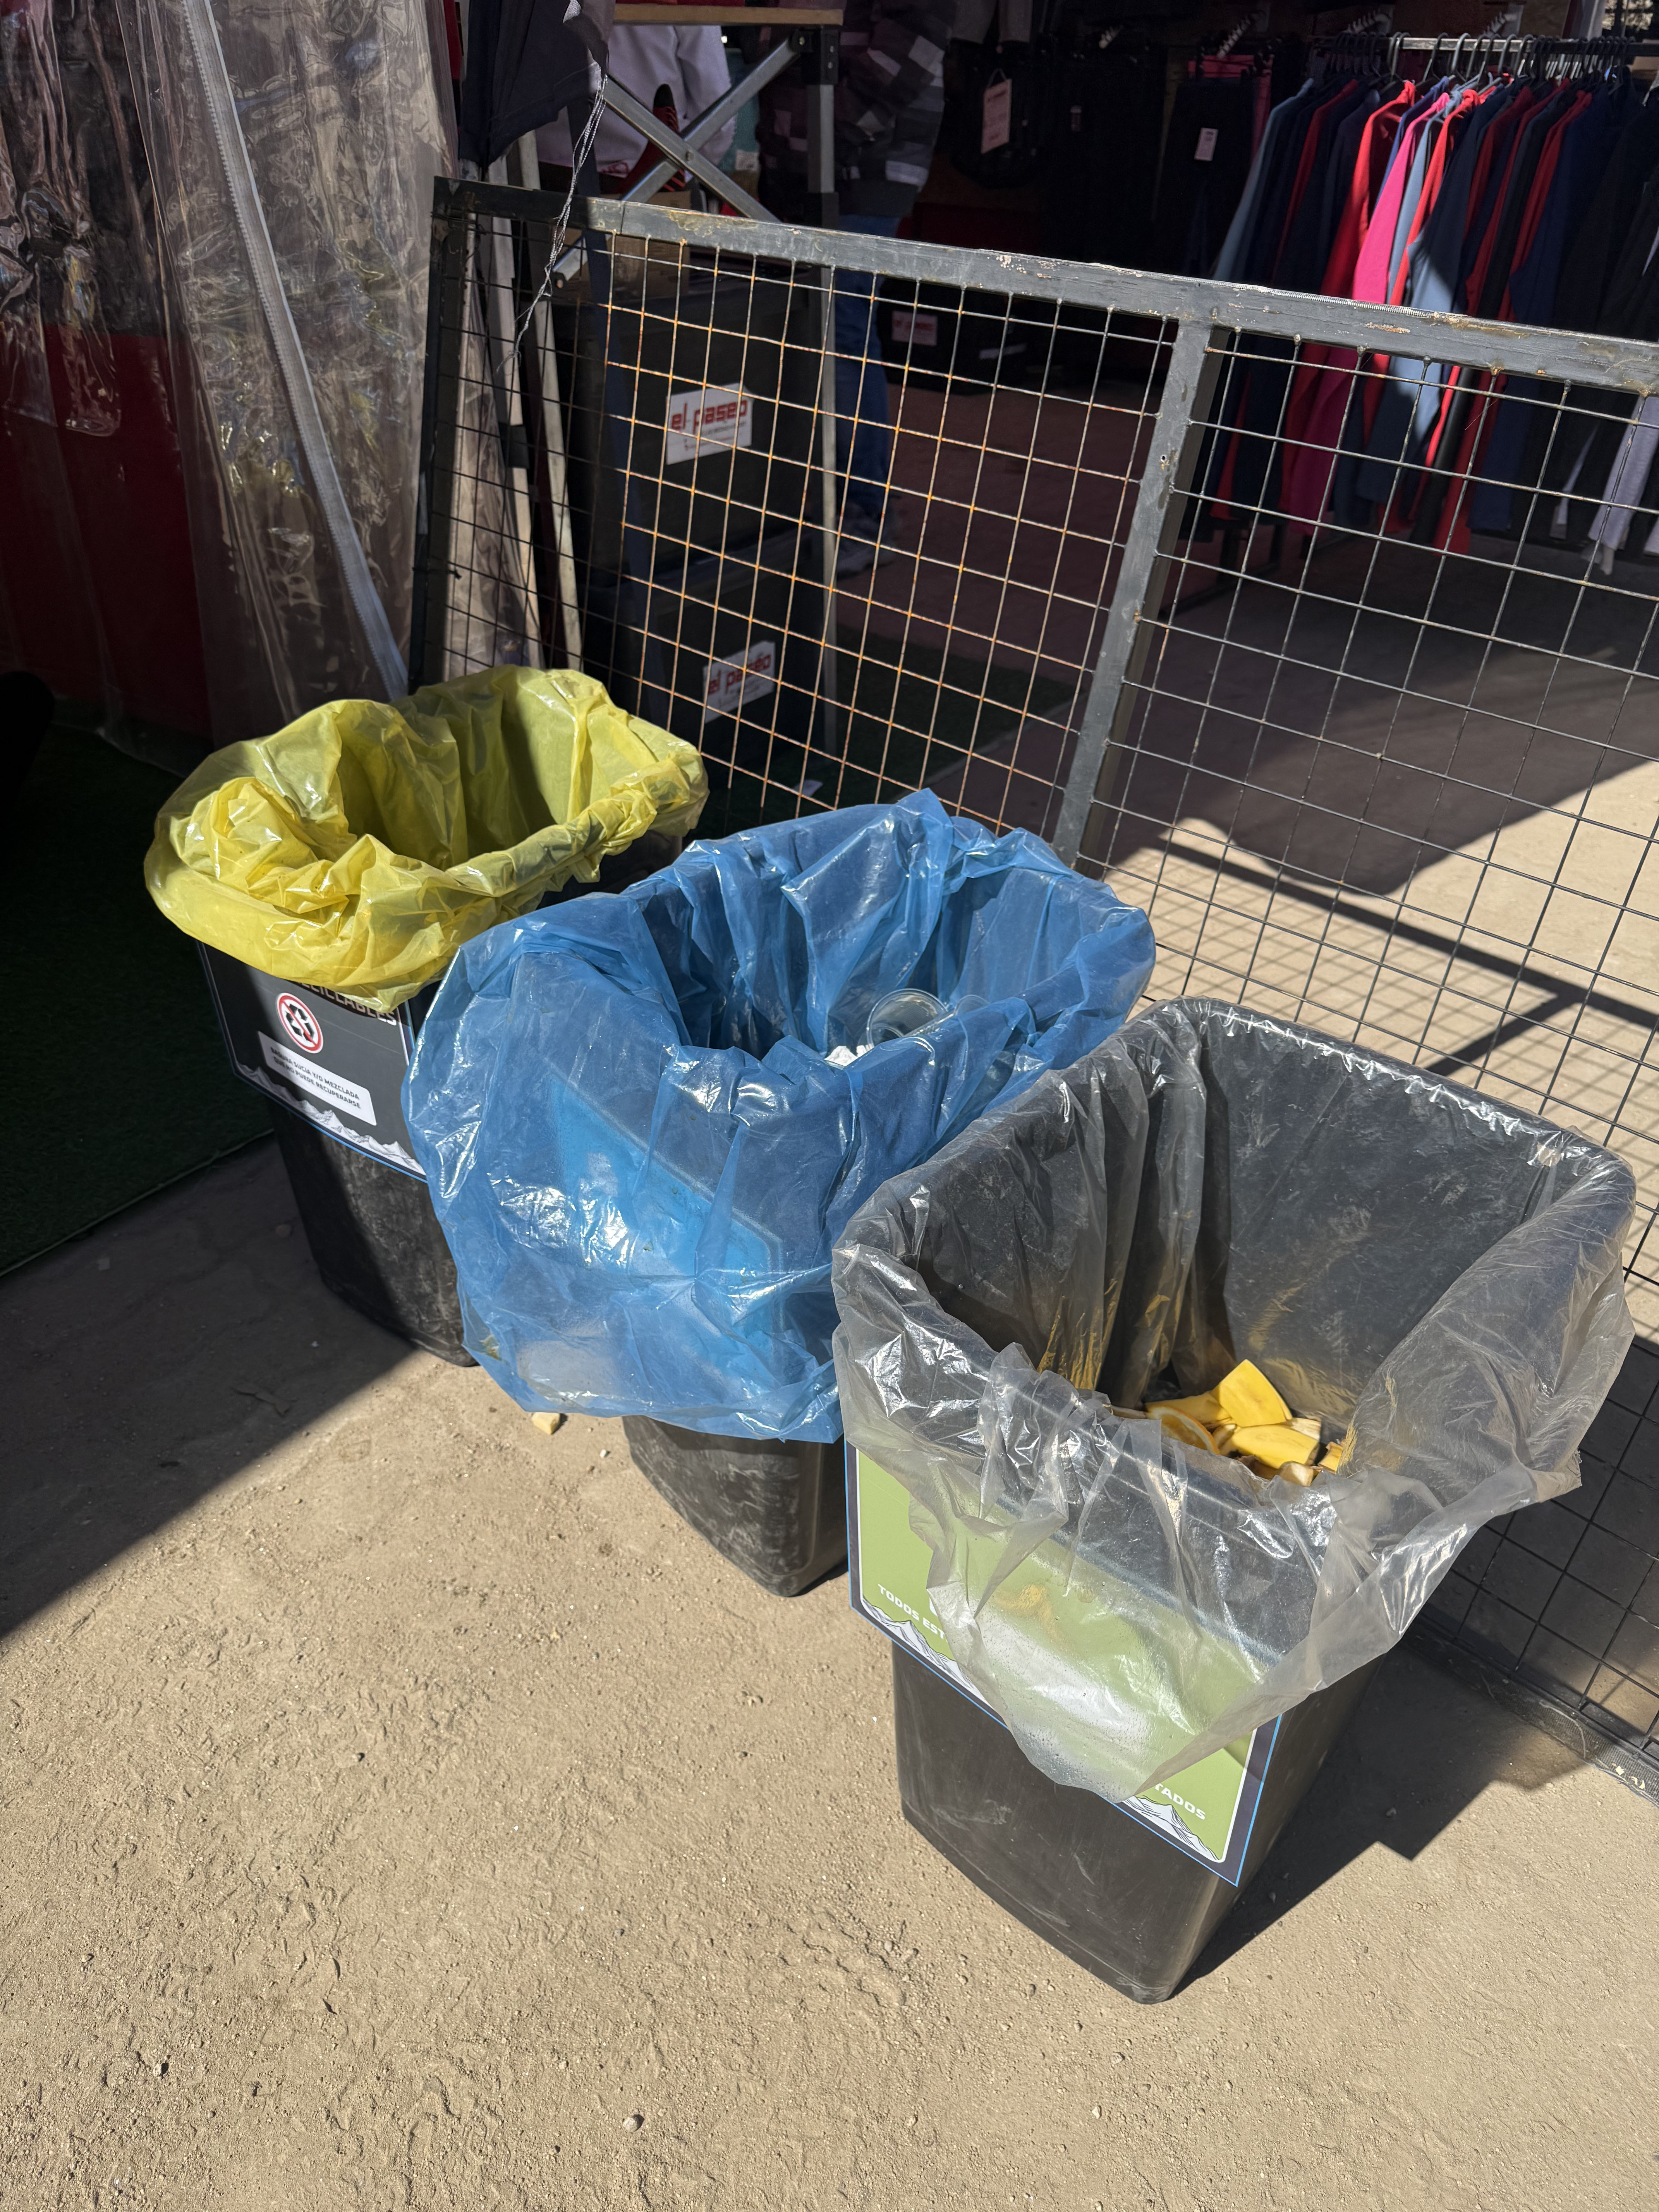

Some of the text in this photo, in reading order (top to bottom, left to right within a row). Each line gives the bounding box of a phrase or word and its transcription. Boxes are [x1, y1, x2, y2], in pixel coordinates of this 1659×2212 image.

[671, 402, 687, 430] el
[692, 400, 747, 434] paseo
[293, 1061, 311, 1075] SUCIA
[324, 1078, 360, 1100] MEZCLADA
[295, 1070, 315, 1085] PUEDE
[316, 1082, 361, 1109] RECUPERARSE
[878, 1583, 1206, 1820] TODOS EST TADOS
